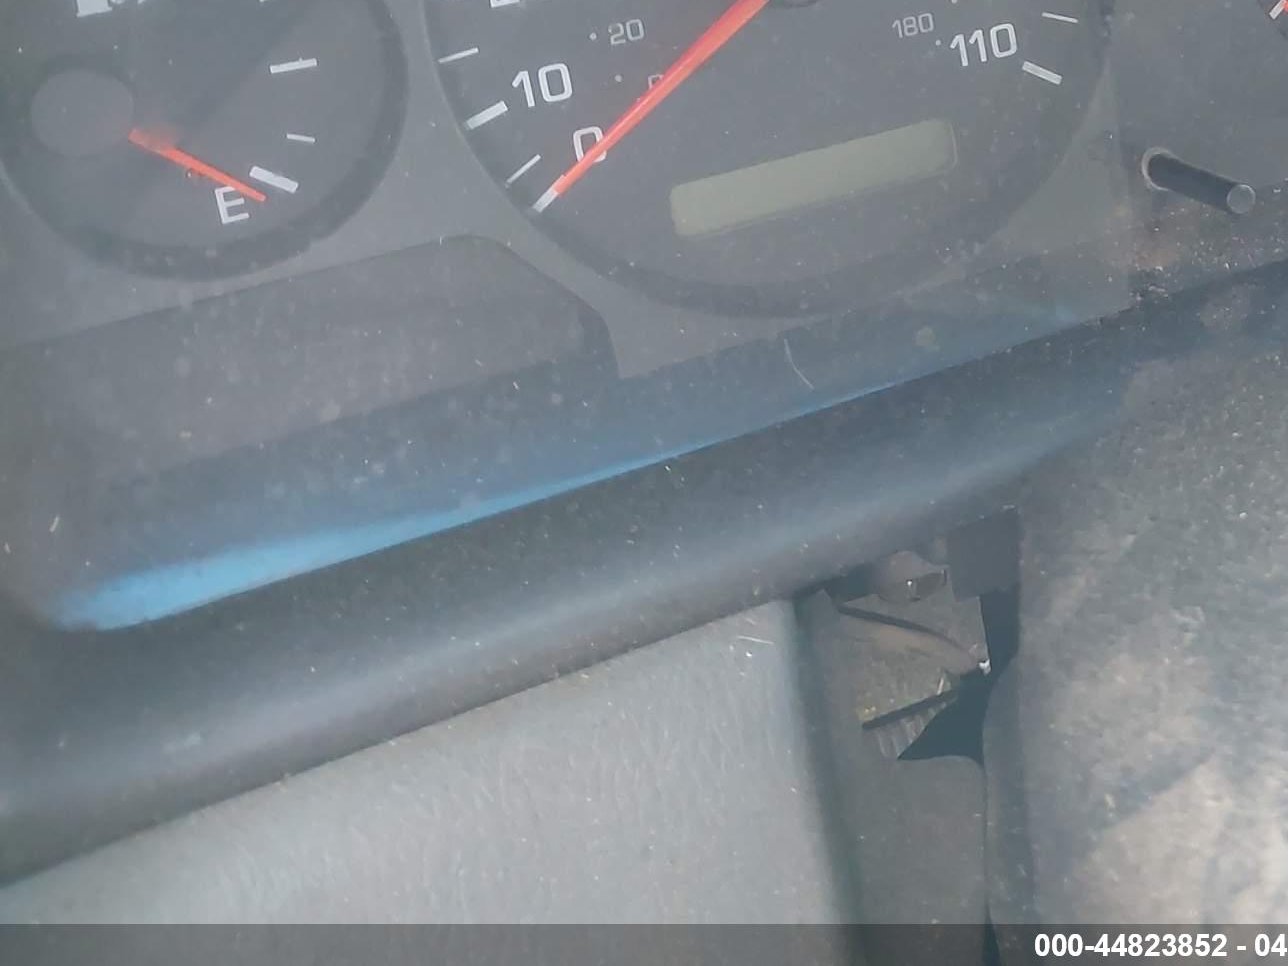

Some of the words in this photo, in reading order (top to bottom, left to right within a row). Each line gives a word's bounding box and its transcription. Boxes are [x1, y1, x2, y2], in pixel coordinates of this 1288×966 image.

[607, 18, 645, 45] 20
[892, 13, 934, 38] 180
[950, 23, 1018, 66] 110
[511, 63, 573, 107] 10
[572, 126, 607, 163] 0
[214, 186, 250, 224] E
